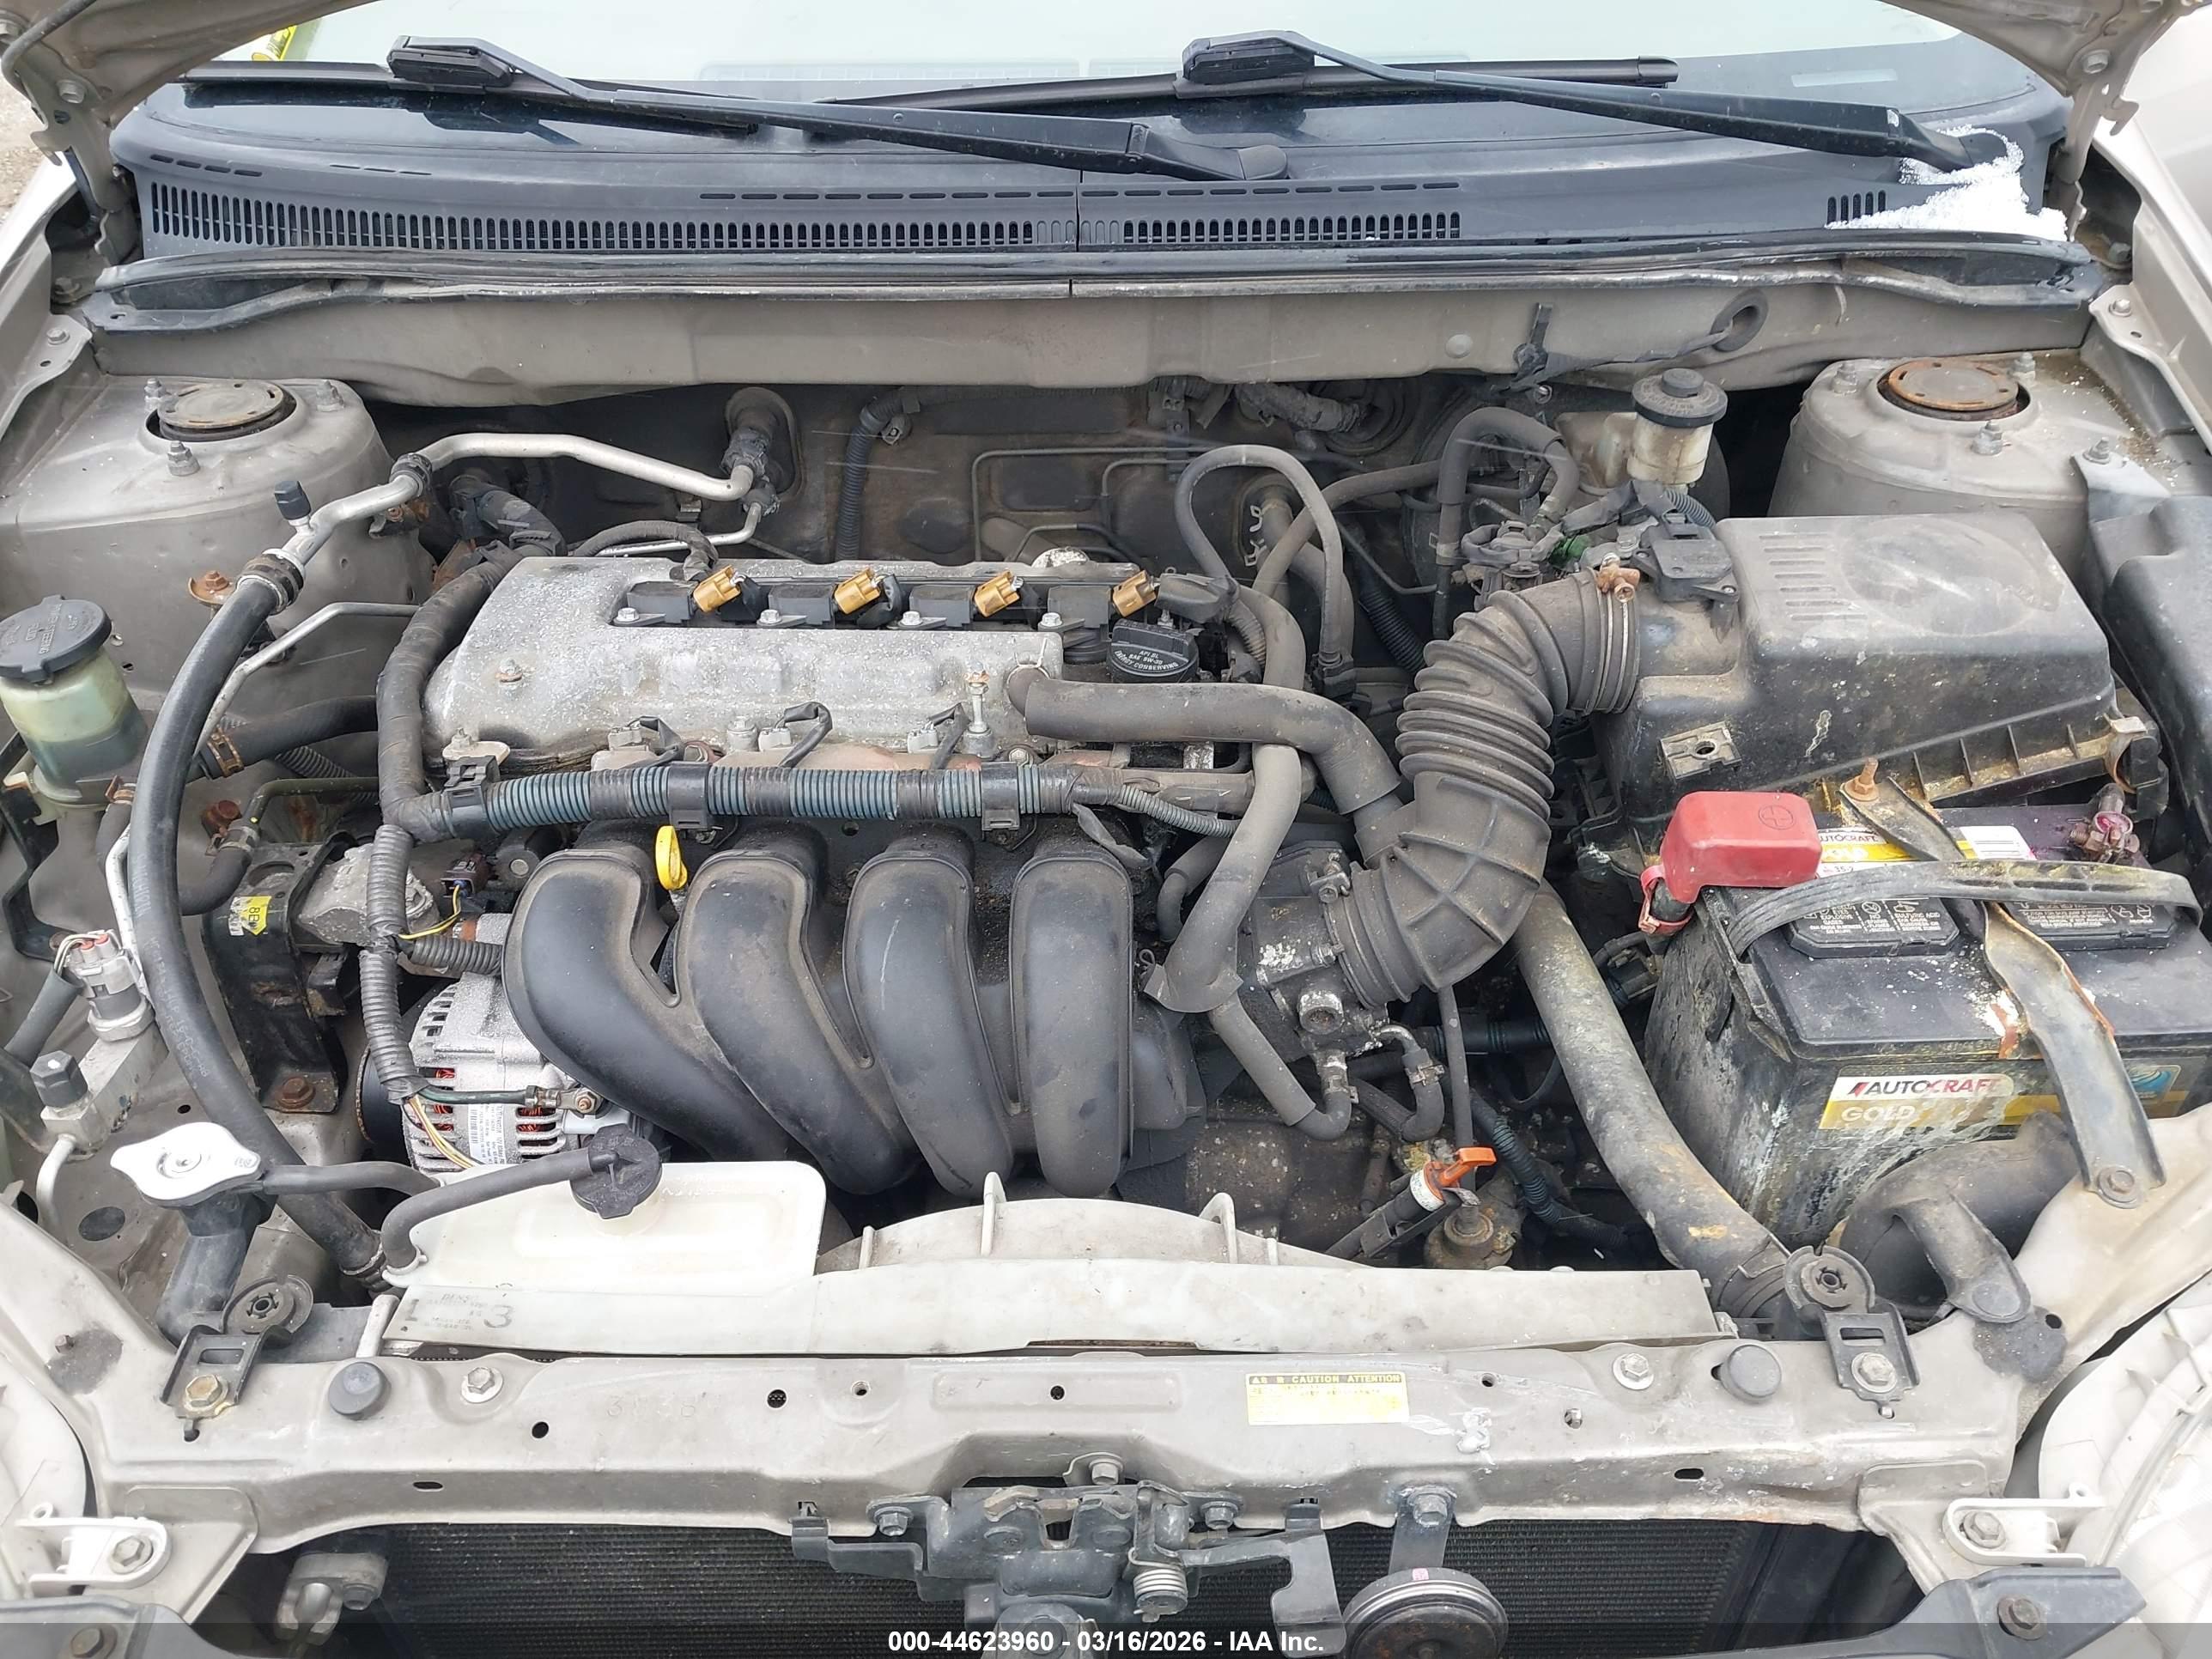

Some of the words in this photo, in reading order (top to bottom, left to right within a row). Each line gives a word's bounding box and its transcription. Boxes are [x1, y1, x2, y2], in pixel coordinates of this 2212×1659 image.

[1115, 650, 1134, 665] ENERGY
[1864, 1079, 2001, 1095] AUTOCRAFT
[1841, 1104, 1916, 1122] GOLD
[1291, 1375, 1340, 1383] CAUTION
[1347, 1373, 1401, 1383] ATTENTION
